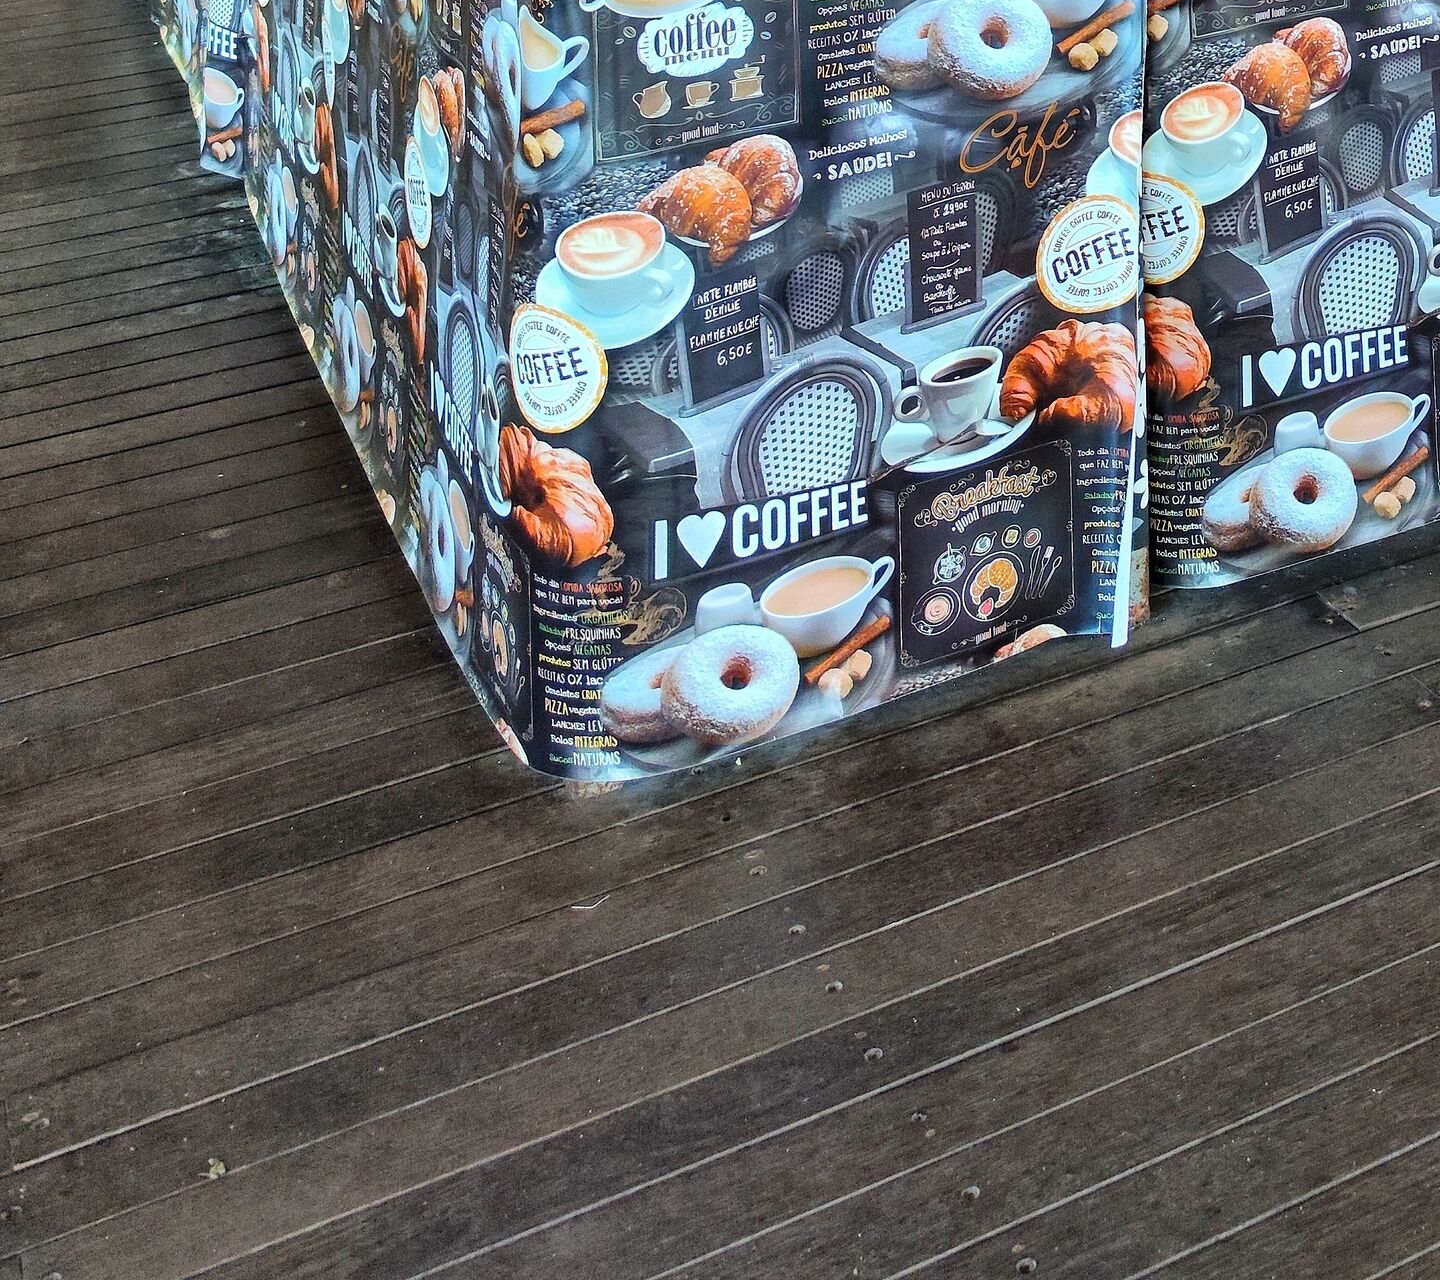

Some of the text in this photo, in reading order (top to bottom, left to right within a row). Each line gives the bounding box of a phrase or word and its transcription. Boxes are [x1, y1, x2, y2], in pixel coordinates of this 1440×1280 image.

[809, 8, 896, 33] produtos SEM GLÚTEN
[654, 12, 736, 57] coffee
[808, 30, 858, 49] RECEITAS 0%
[1355, 23, 1401, 41] Deliciosos
[665, 47, 731, 66] menu
[1370, 35, 1420, 60] SAÚDE!
[817, 63, 843, 79] PIZZA
[848, 100, 892, 121] NATURAIS
[682, 122, 719, 143] good food
[808, 139, 866, 161] Deliciosos
[827, 151, 893, 182] SAÚDE!
[921, 189, 941, 203] MENU
[1052, 227, 1134, 284] COFFEE
[517, 346, 588, 385] COFFEE
[1241, 324, 1409, 408] I COFFEE
[445, 392, 473, 486] COFFEE
[1096, 460, 1109, 469] FAZ
[1112, 459, 1123, 469] BEM
[930, 465, 1040, 521] Breakfast
[953, 496, 1021, 534] good morning
[654, 480, 870, 580] I COFFEE
[1082, 535, 1114, 544] RECEITAS
[1092, 561, 1117, 574] PIZZA
[549, 592, 559, 603] FAZ
[561, 594, 574, 605] BEM
[565, 628, 621, 640] FRESQUINHAS
[539, 654, 589, 670] produtos SEM
[568, 674, 583, 685] 0%
[545, 700, 569, 716] PIZZA
[551, 719, 585, 731] LANCHES
[573, 751, 620, 766] NATURAIS
